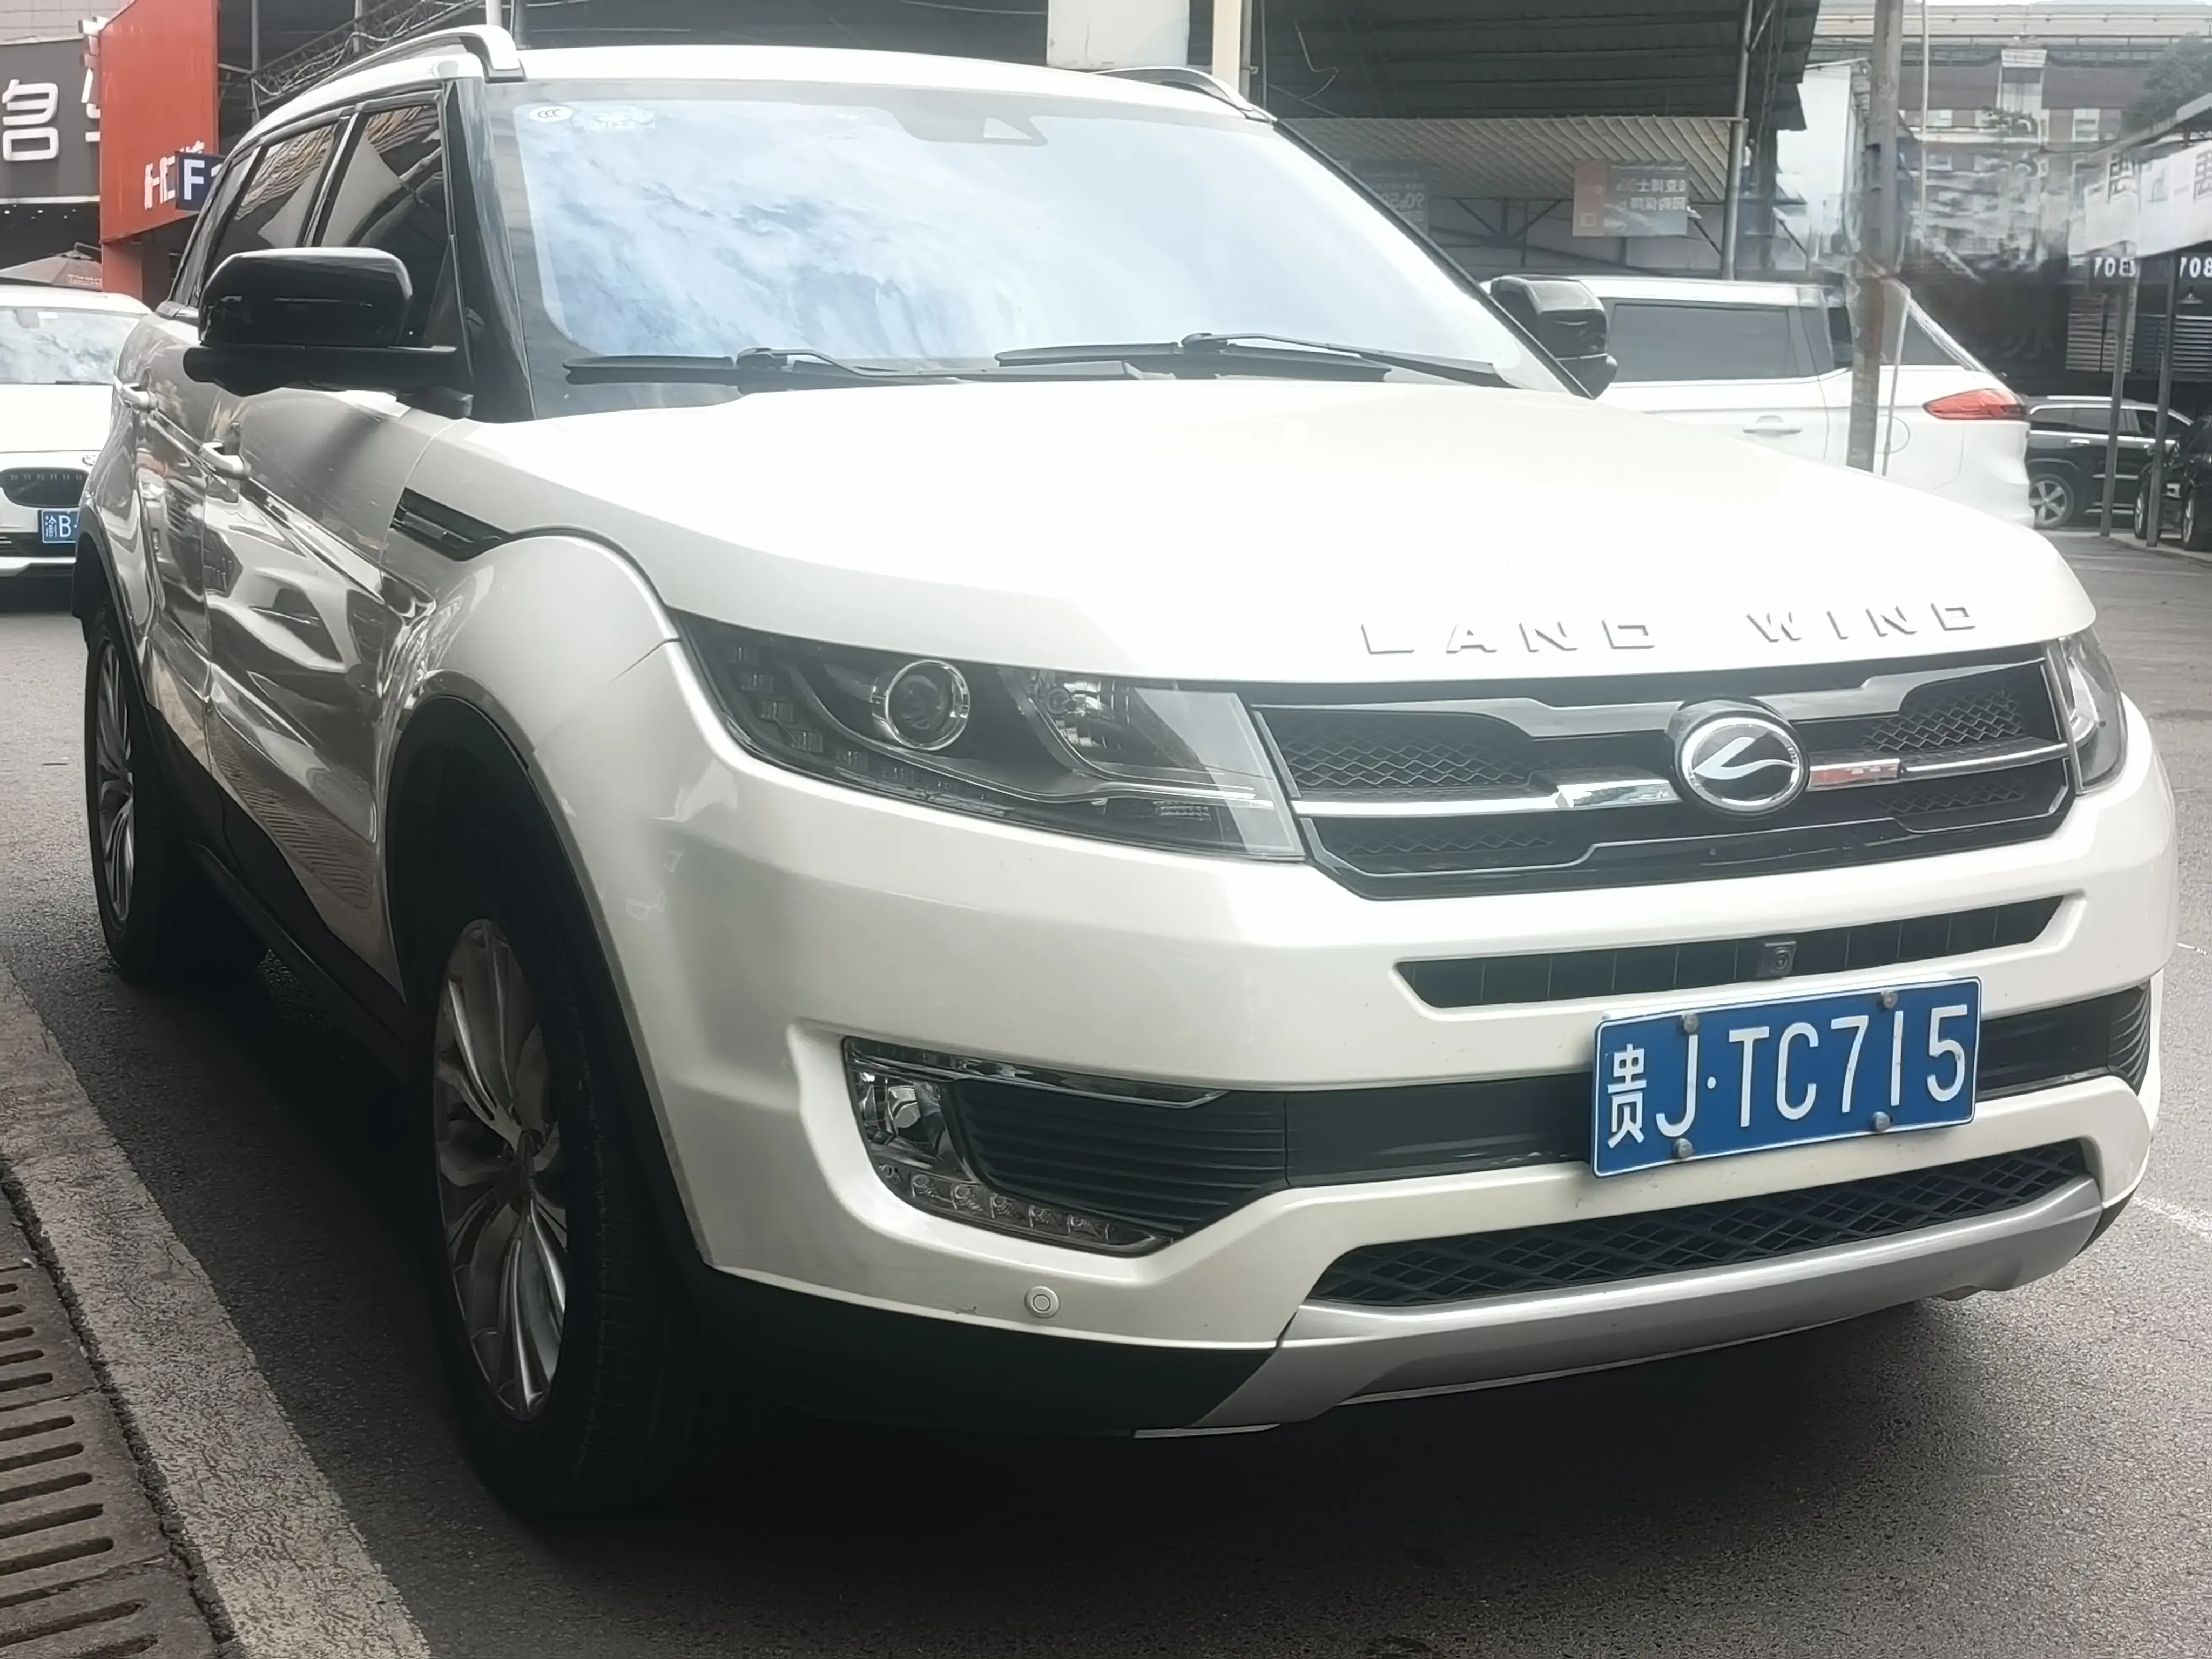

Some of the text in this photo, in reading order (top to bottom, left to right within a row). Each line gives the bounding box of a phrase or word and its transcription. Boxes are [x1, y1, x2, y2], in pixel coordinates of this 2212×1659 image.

[183, 159, 222, 200] F
[1360, 602, 1977, 655] LAND WIND
